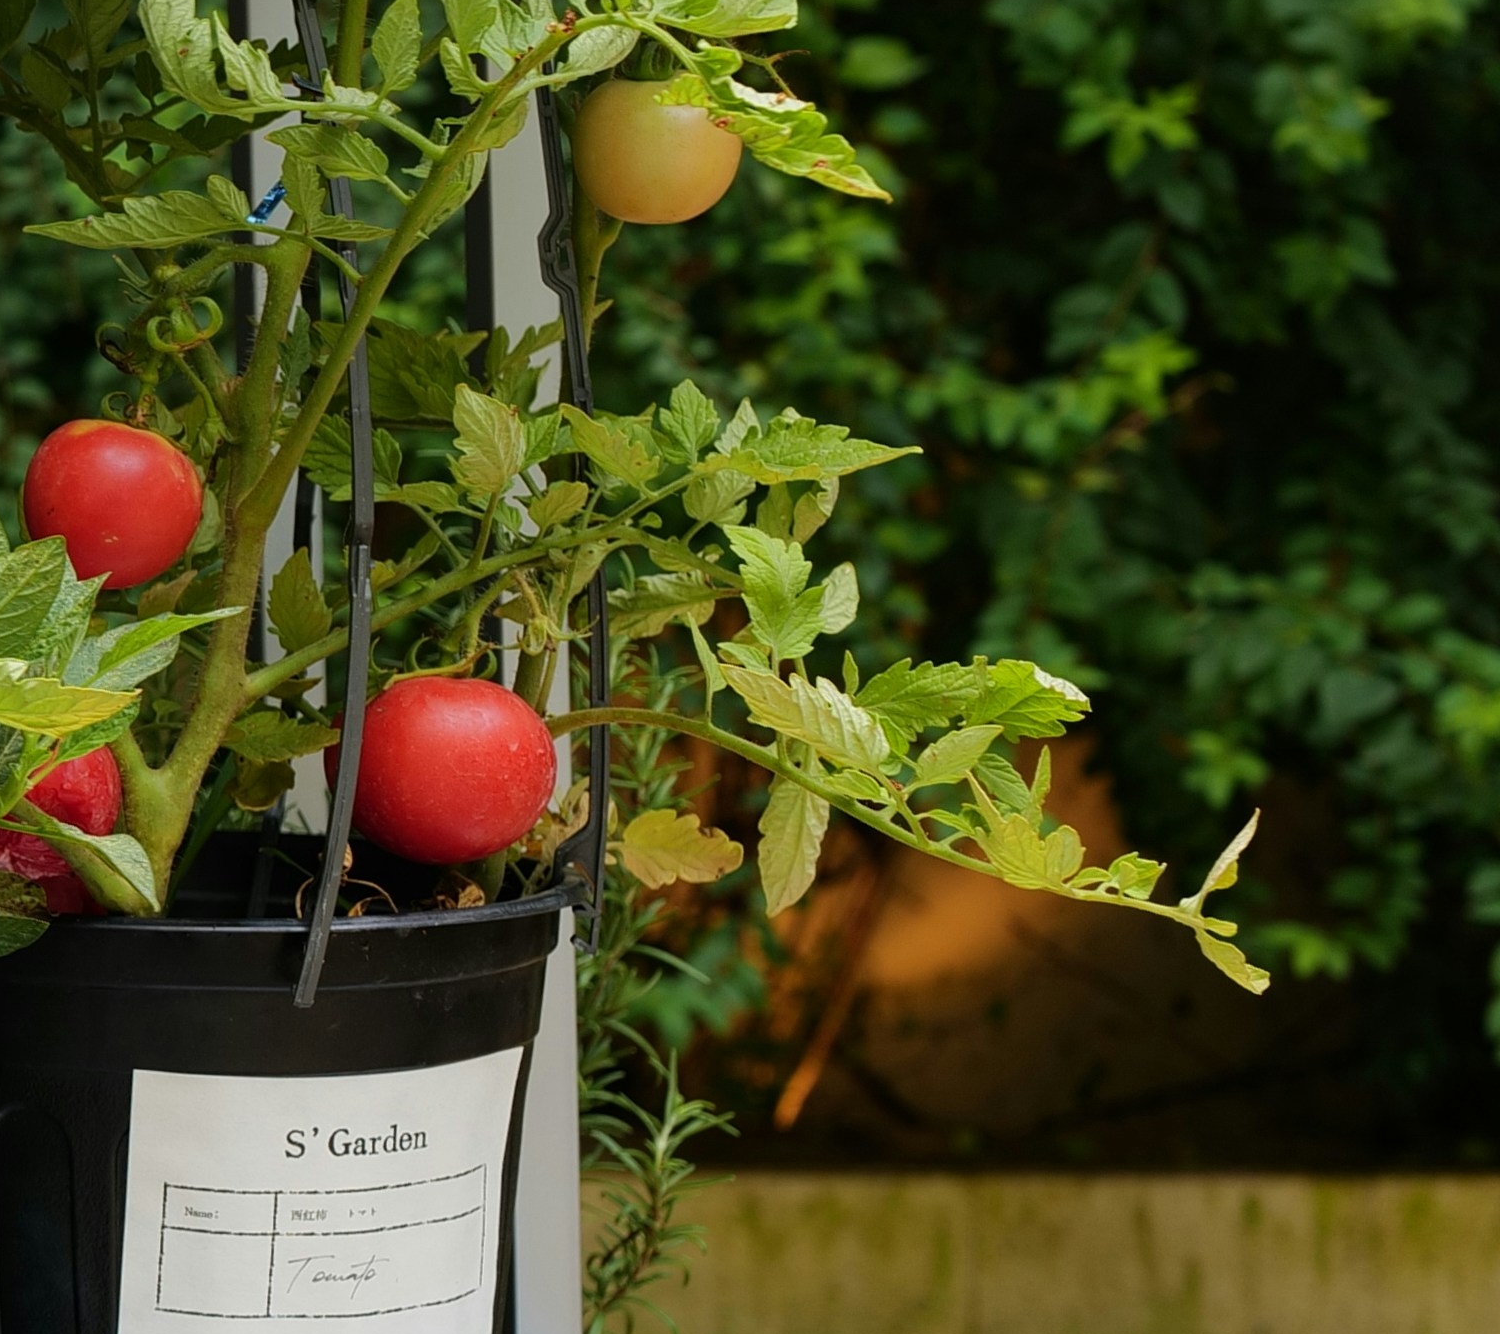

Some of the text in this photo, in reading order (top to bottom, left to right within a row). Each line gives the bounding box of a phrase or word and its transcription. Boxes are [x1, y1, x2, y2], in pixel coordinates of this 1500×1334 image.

[284, 1123, 428, 1159] S' Garden
[183, 1205, 219, 1219] Name:
[286, 1254, 390, 1300] Tomato
